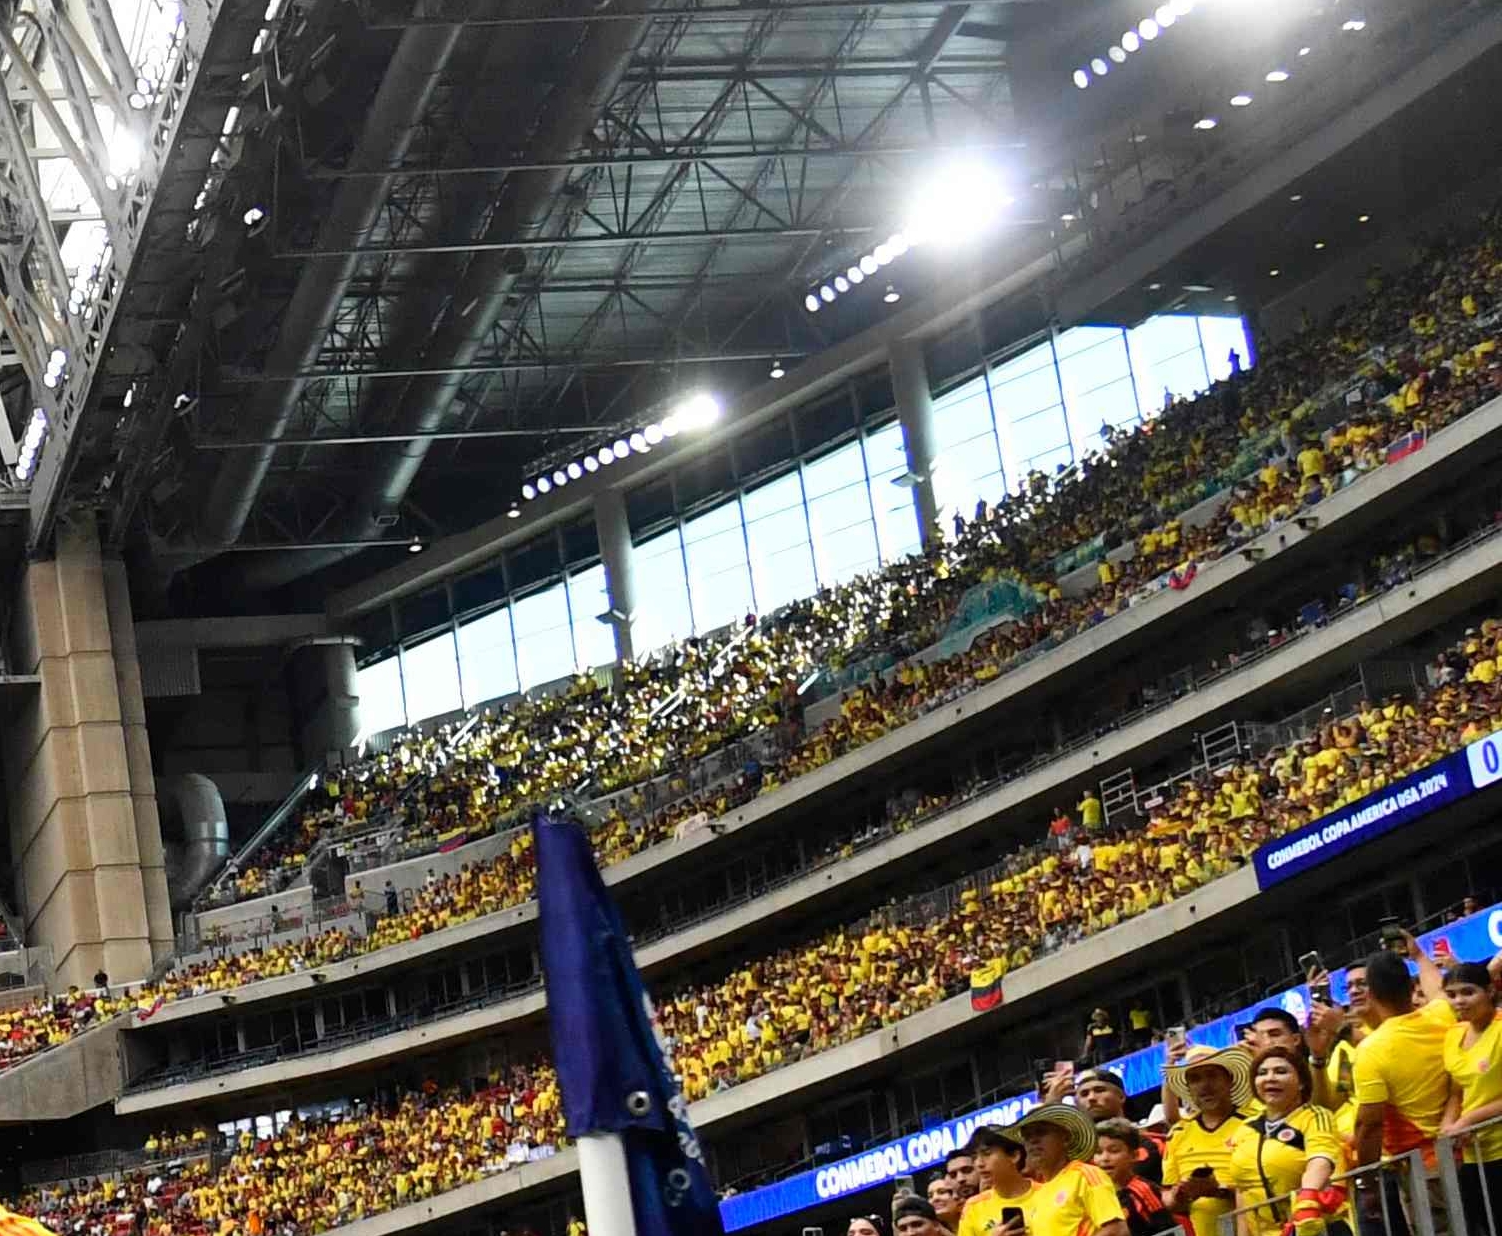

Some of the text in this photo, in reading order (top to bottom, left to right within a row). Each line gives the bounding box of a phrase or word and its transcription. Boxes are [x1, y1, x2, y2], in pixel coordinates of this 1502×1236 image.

[1482, 740, 1499, 774] 0
[1267, 772, 1449, 870] CONMEBOL COPA AMERICA USA 2024
[815, 1144, 909, 1198] CONMEBOL
[907, 1126, 954, 1168] COPA
